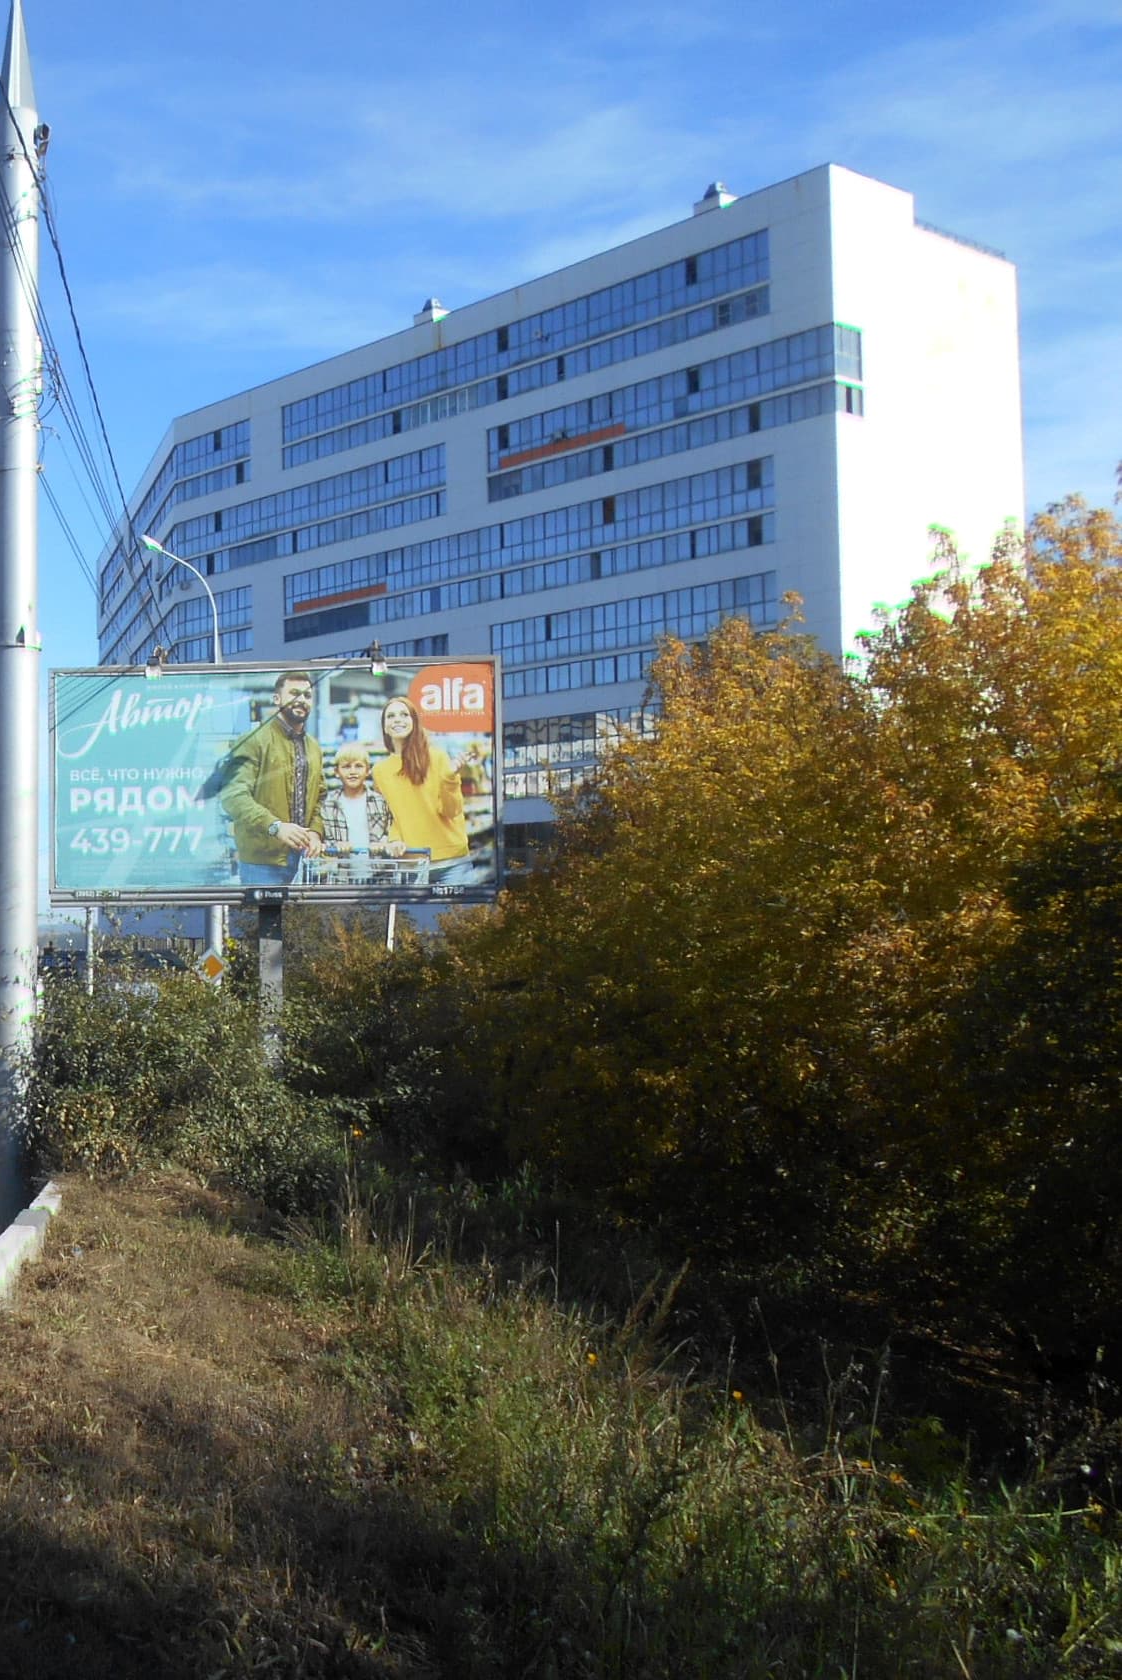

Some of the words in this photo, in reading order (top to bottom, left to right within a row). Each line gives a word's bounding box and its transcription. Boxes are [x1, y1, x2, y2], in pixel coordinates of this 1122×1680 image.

[420, 677, 484, 711] alfa
[59, 688, 251, 758] Автор
[107, 768, 140, 781] ЧТО
[69, 785, 205, 816] РЯДОМ
[69, 826, 205, 855] 439-777
